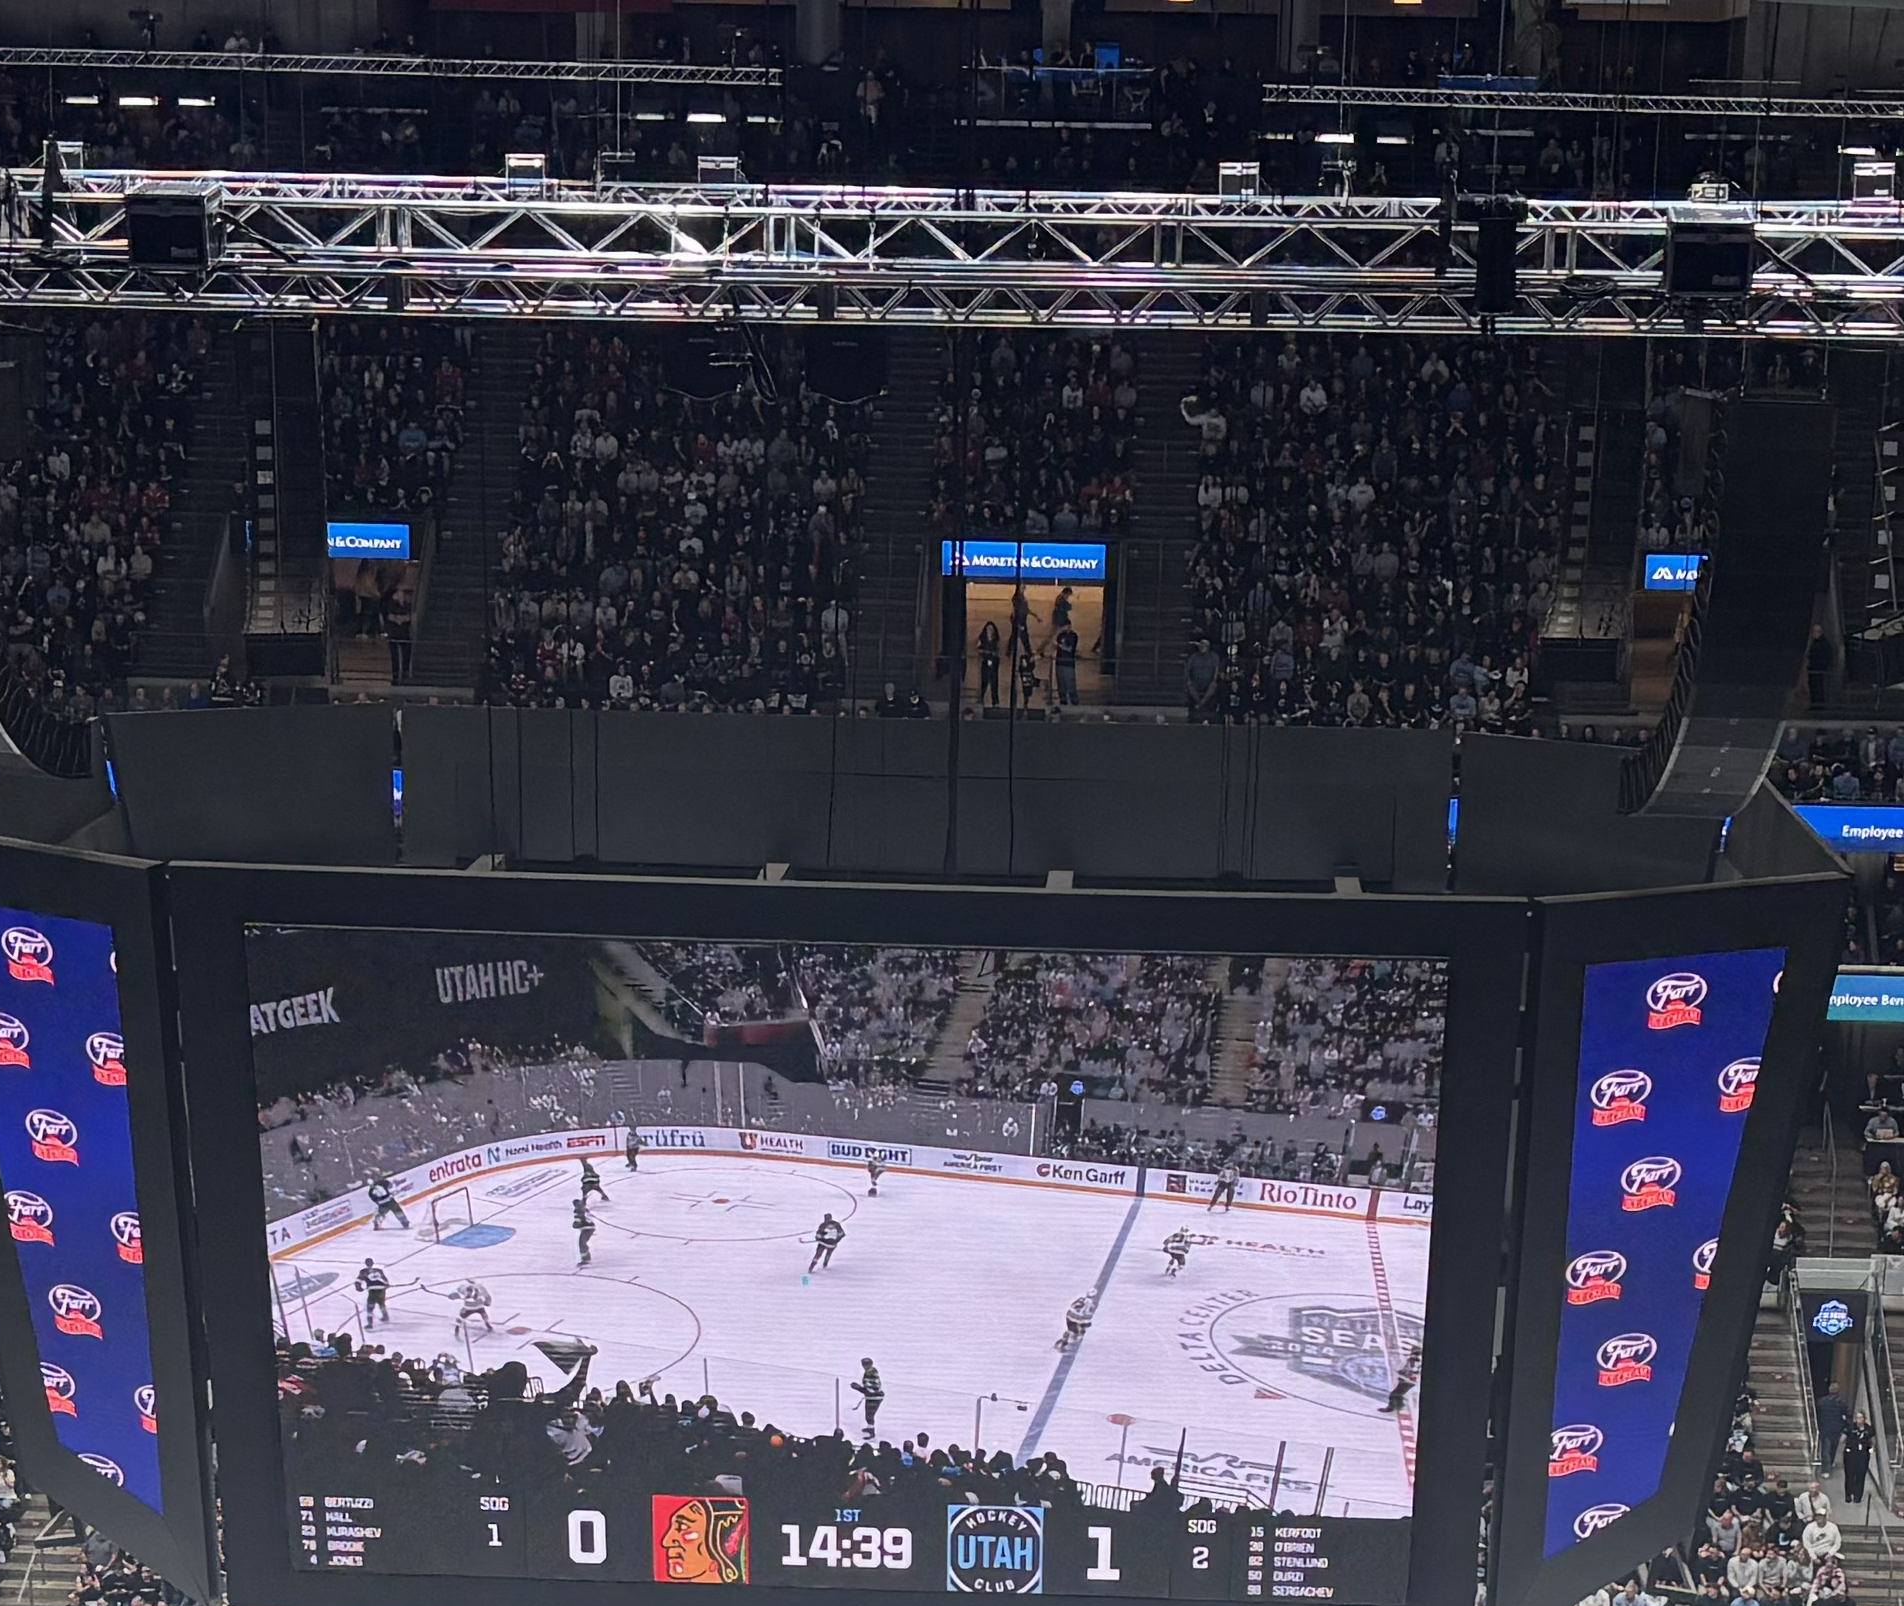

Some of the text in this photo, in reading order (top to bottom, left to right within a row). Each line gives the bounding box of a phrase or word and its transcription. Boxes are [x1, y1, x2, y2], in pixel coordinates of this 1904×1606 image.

[436, 959, 544, 1003] UTAH HC+
[566, 1135, 605, 1148] ESPN
[760, 1135, 803, 1152] HEALTH
[429, 1151, 481, 1184] entrata
[1051, 1164, 1126, 1186] Ken Garff
[480, 1496, 509, 1512] SOG
[835, 1508, 860, 1523] 1ST
[965, 1509, 1029, 1532] HOCKEY
[1187, 1519, 1217, 1534] SOG
[487, 1523, 503, 1547] 1
[567, 1509, 607, 1564] 0
[780, 1523, 913, 1570] 14:39
[957, 1534, 1033, 1571] UTAH
[1086, 1526, 1121, 1581] 1
[1193, 1546, 1208, 1570] 2
[973, 1577, 1015, 1593] CLUB
